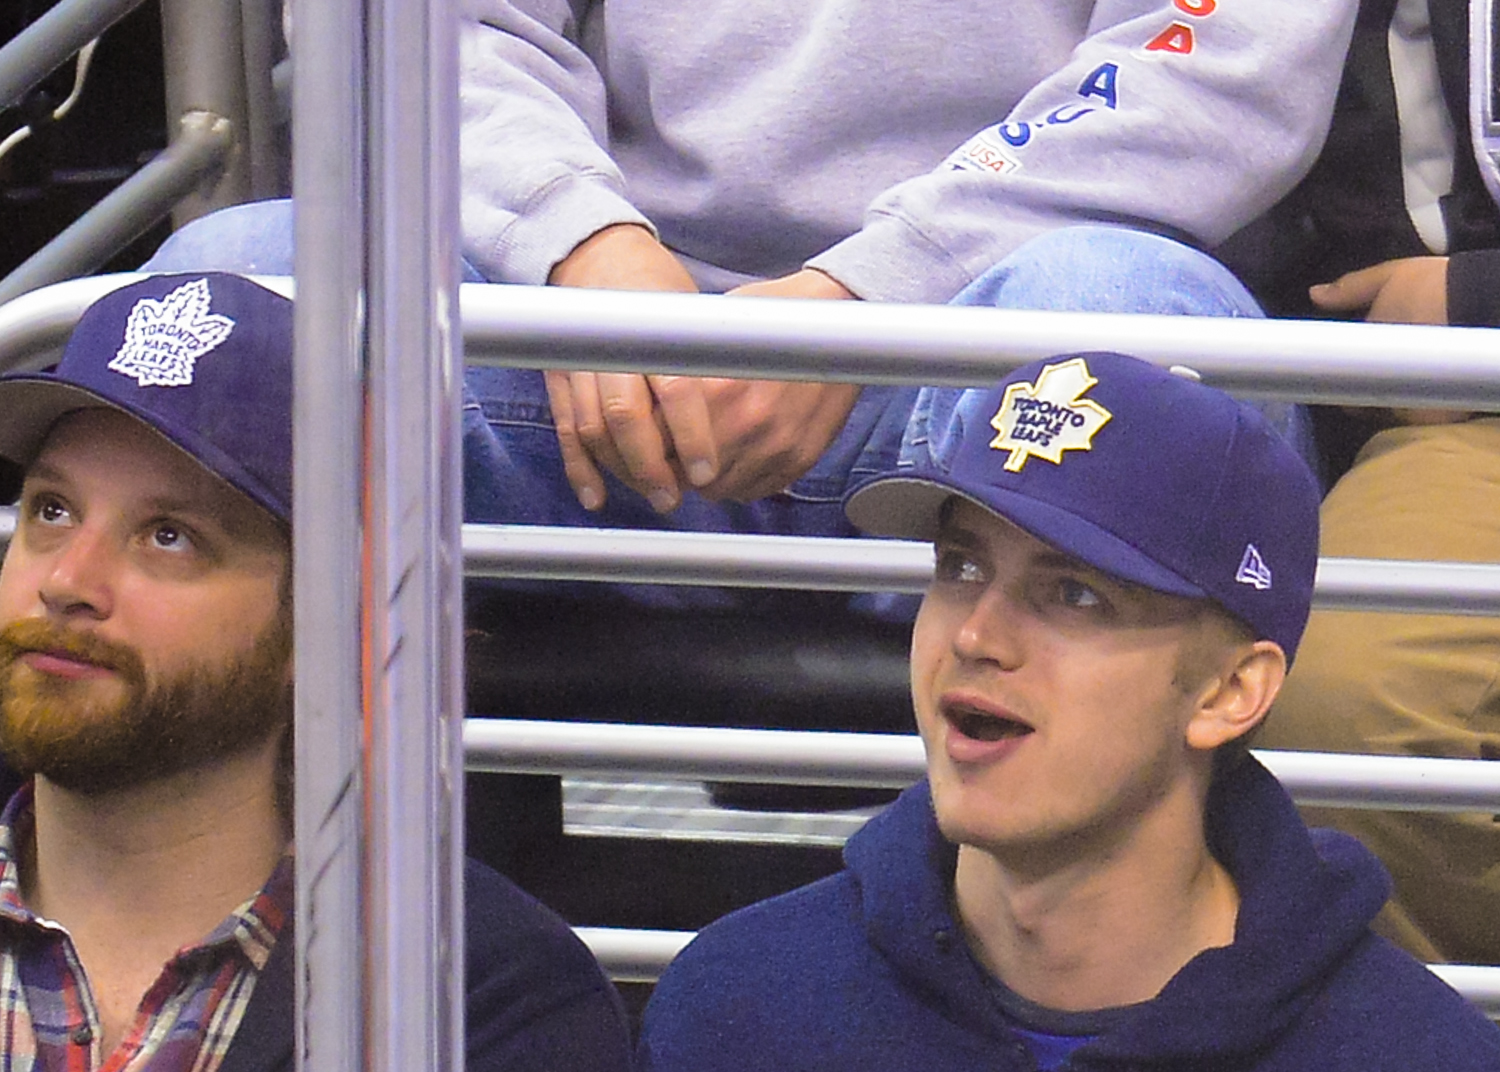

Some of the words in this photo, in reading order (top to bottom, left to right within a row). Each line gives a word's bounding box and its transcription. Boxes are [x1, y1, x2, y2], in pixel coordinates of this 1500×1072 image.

[969, 143, 1004, 172] USA
[141, 322, 201, 351] TORONTO
[134, 350, 178, 369] LEAFS
[1012, 397, 1085, 427] TORONTO
